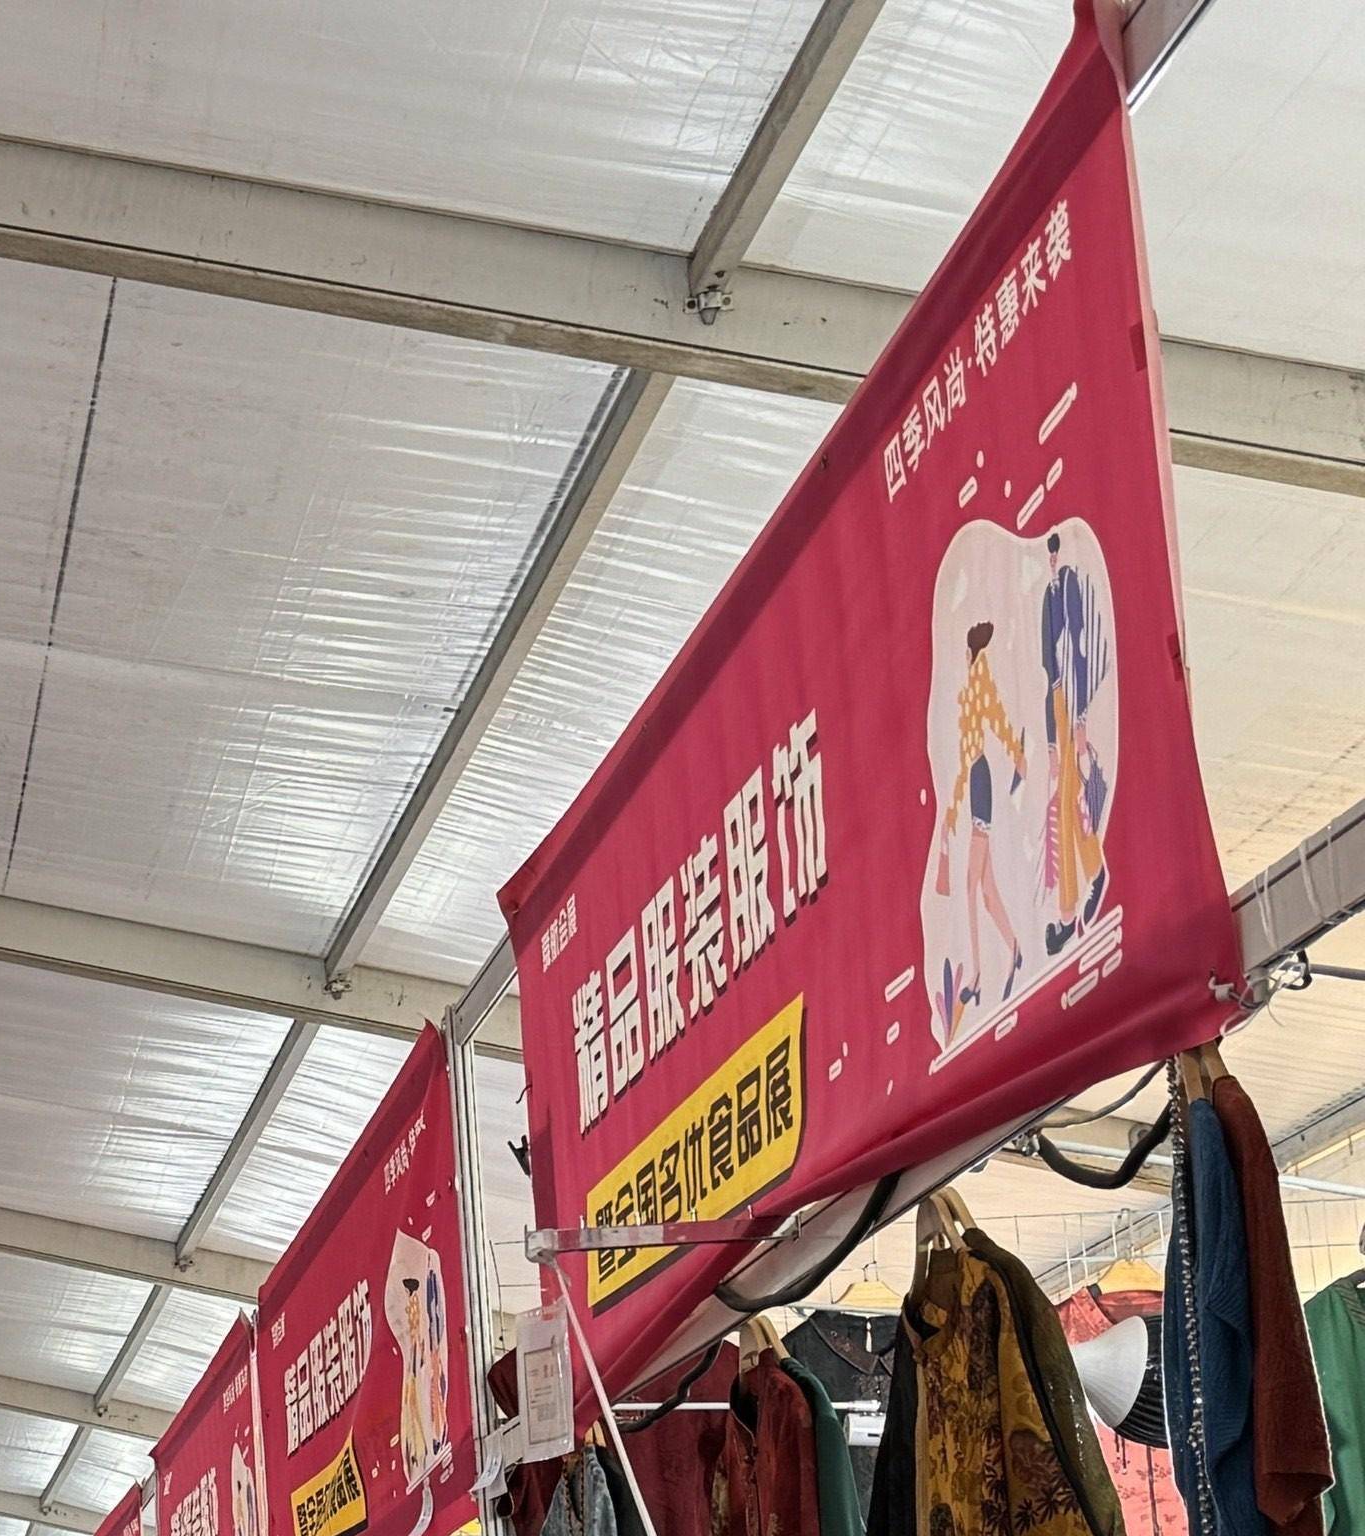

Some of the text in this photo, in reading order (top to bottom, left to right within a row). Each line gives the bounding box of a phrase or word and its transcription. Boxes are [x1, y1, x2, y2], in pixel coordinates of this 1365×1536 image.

[884, 200, 1072, 502] 四季风尚·特惠来袭
[572, 709, 828, 1134] 精品服装服饰
